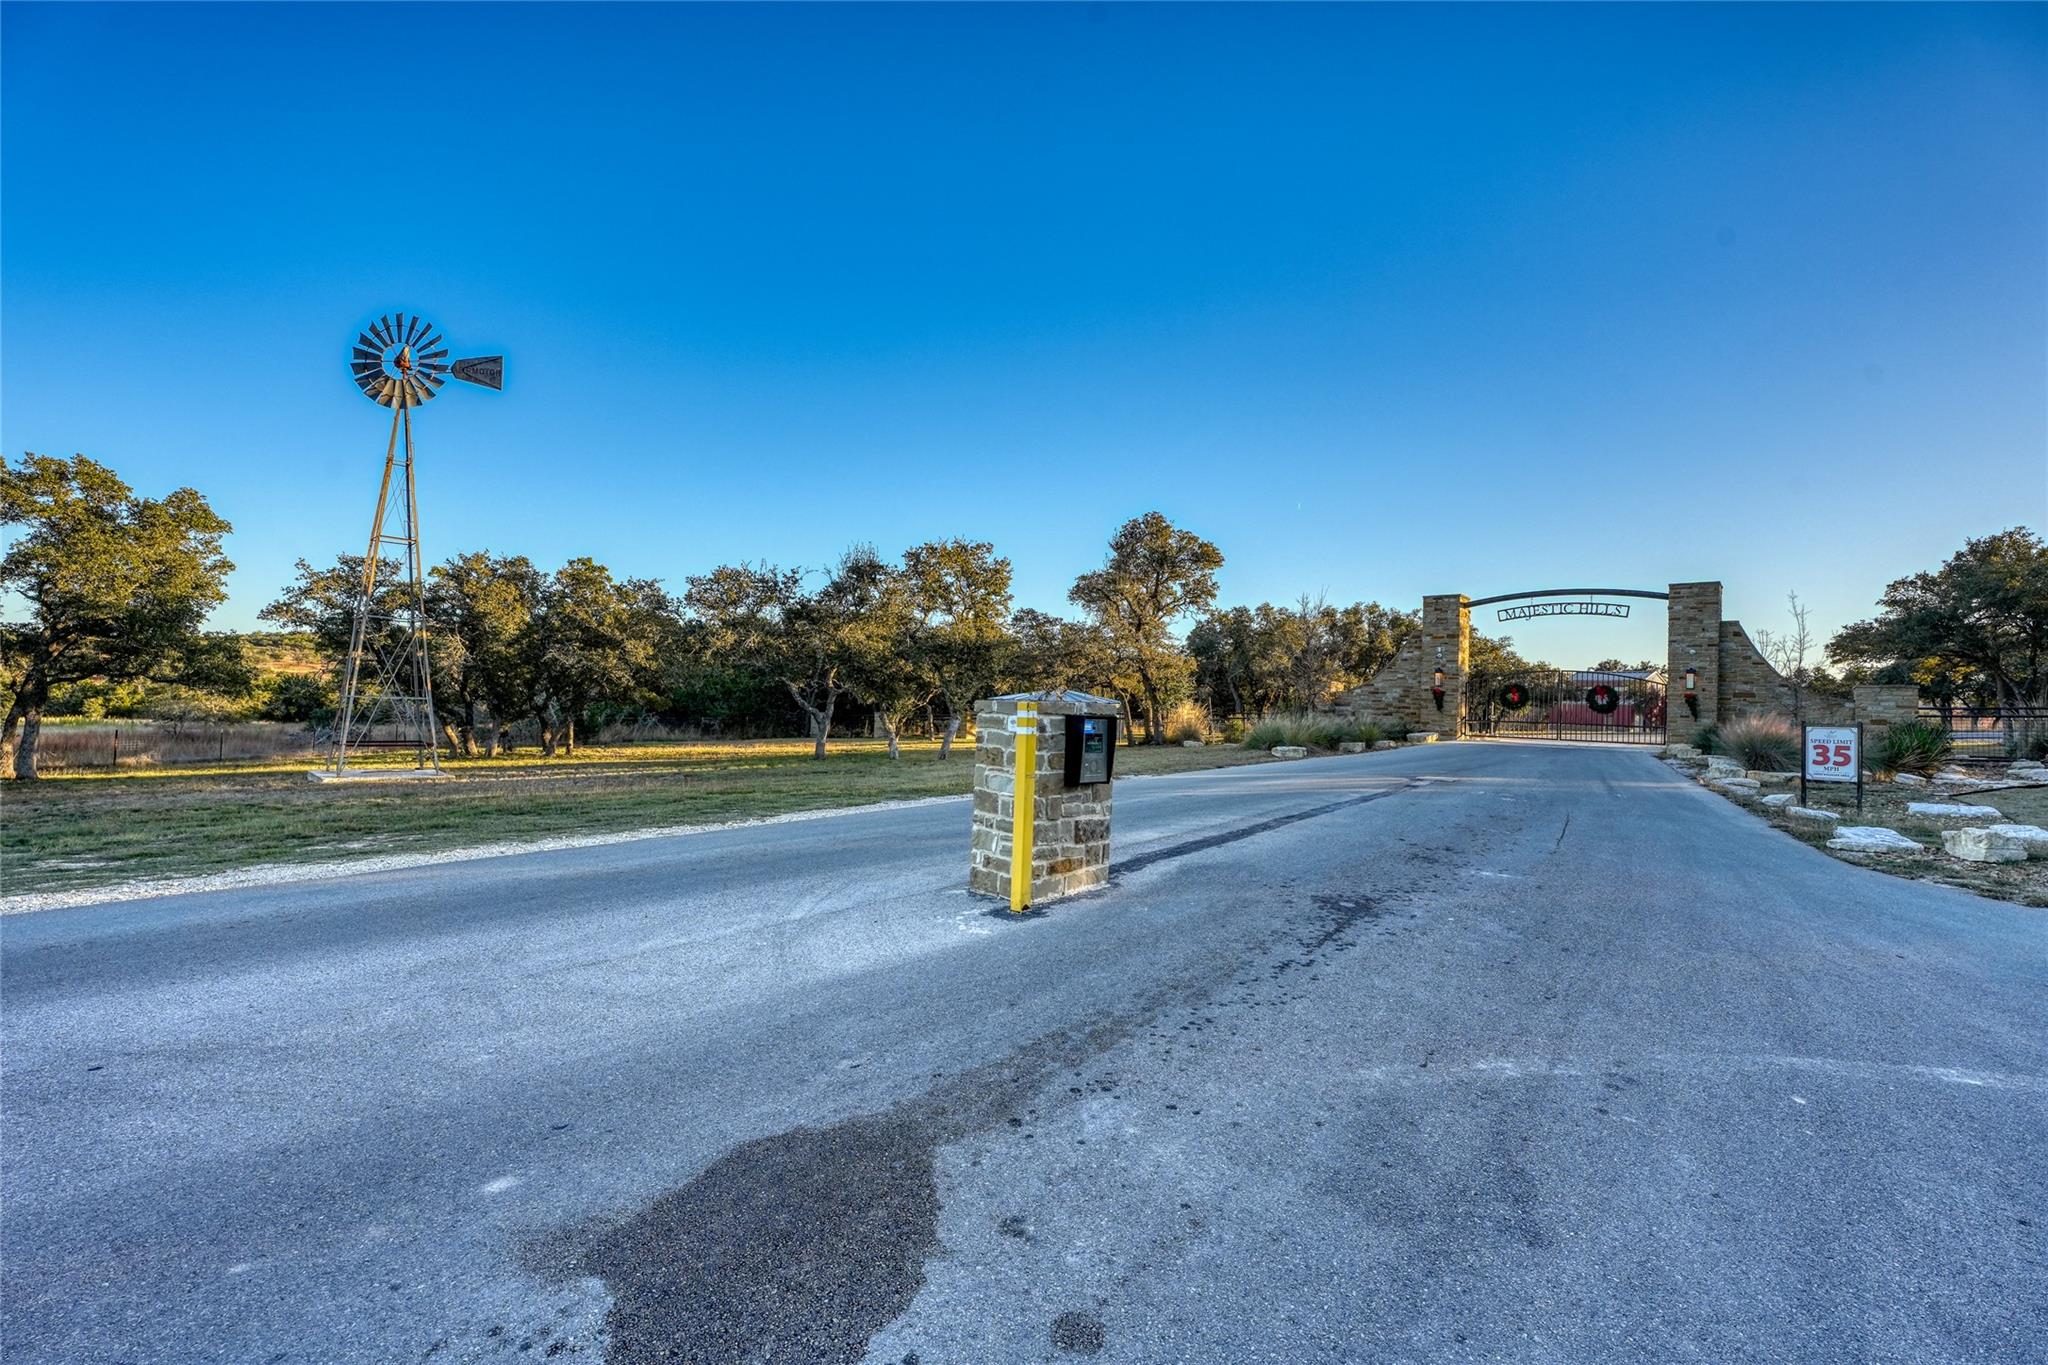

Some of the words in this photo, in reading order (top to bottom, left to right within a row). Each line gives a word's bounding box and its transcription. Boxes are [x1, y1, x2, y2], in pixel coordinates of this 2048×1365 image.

[1504, 603, 1574, 621] MAJESTIC
[1579, 603, 1622, 617] HILLS
[1812, 744, 1852, 767] 35
